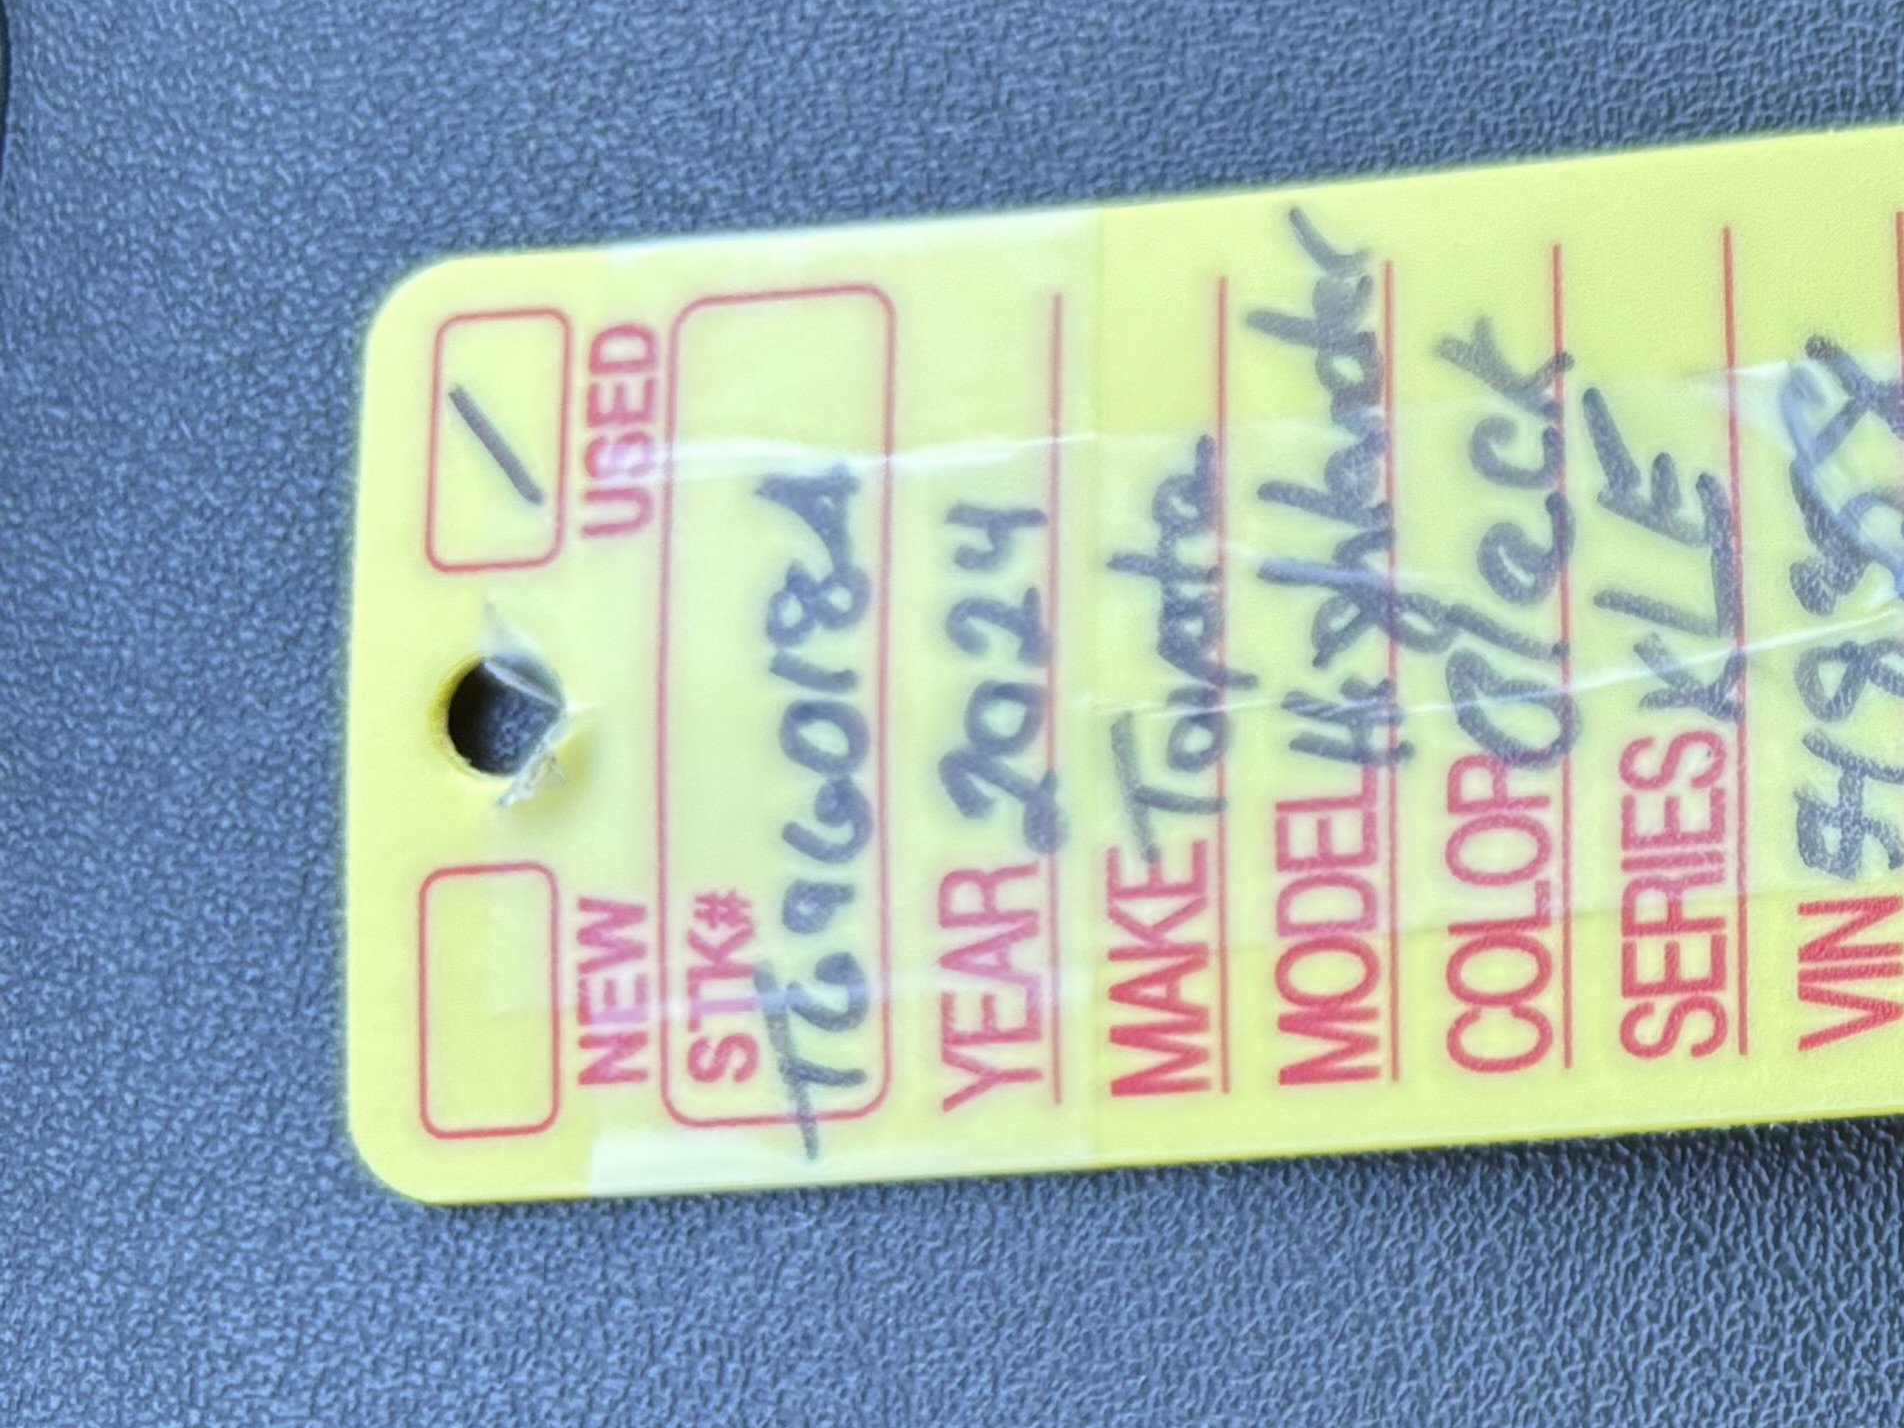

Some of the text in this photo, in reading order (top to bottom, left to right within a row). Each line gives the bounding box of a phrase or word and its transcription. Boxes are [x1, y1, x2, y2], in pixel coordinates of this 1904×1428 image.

[580, 322, 661, 539] USED
[1245, 206, 1460, 767] Highlander
[938, 503, 1068, 855] 2024
[1106, 433, 1260, 864] Toyota
[579, 896, 650, 1087] NEW
[686, 888, 760, 1086] STK#
[937, 860, 1044, 1113] YEAR
[1105, 838, 1214, 1099] MAKE
[1274, 762, 1382, 1086] MODEL
[1444, 752, 1554, 1074] COLOR
[1619, 728, 1729, 1059] SERIES
